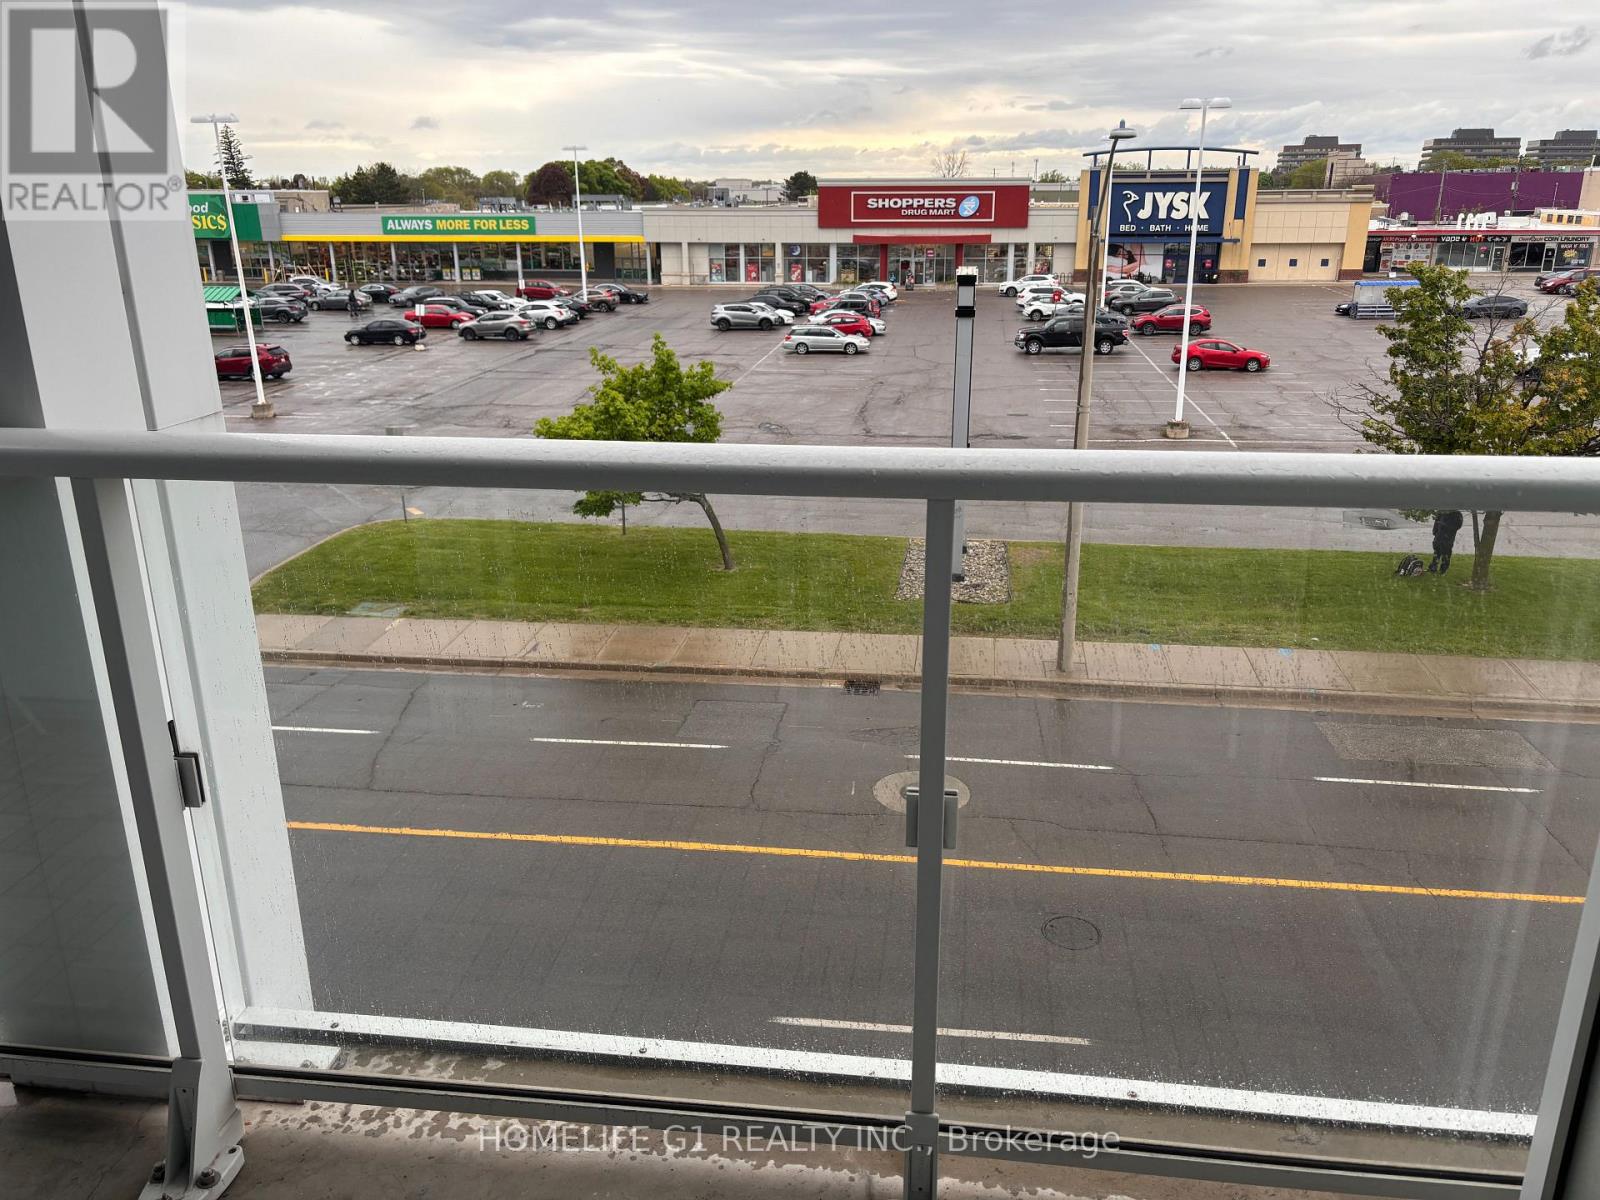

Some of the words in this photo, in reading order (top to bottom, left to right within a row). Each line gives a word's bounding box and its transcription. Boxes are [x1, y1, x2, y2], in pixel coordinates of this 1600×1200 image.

[867, 198, 957, 209] SHOPPERS
[1137, 191, 1211, 219] JYSK
[387, 219, 432, 230] ALWAYS
[436, 219, 470, 230] MORE
[474, 219, 497, 230] FOR
[500, 219, 529, 230] LESS
[1119, 224, 1136, 232] BED
[1149, 224, 1171, 232] BATH
[1184, 224, 1209, 232] HME
